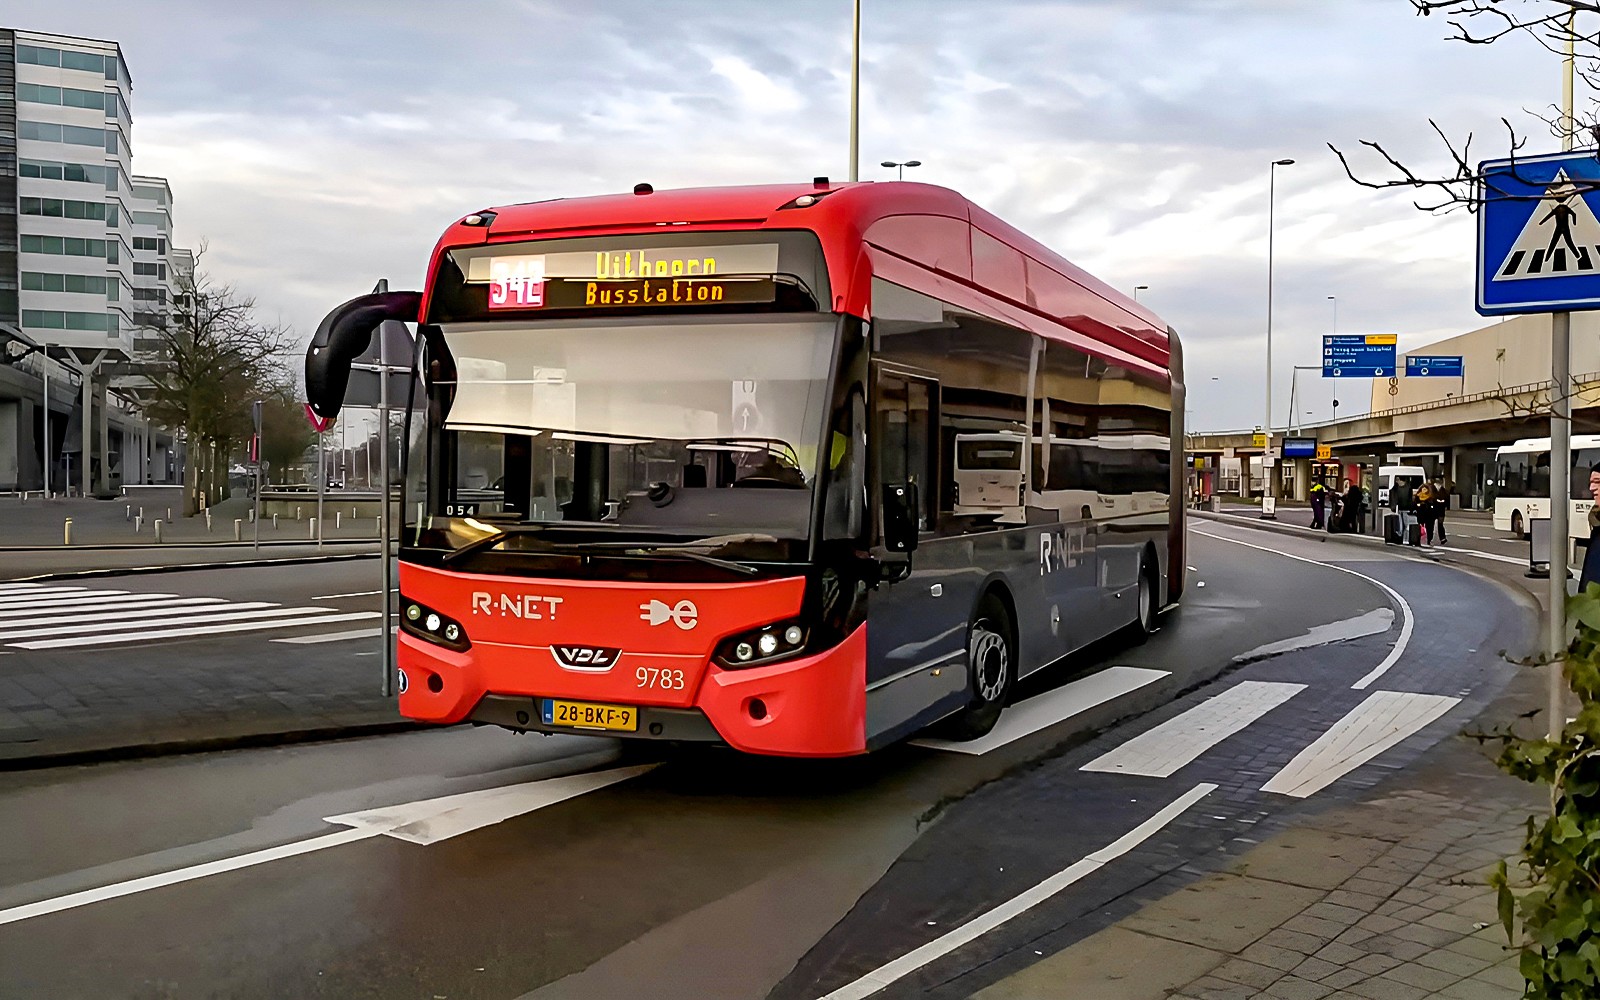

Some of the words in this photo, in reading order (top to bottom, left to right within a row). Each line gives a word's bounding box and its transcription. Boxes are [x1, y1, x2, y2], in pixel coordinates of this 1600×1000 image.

[596, 250, 716, 279] Uithoorn
[586, 280, 723, 305] Busstation
[446, 505, 474, 516] 054
[560, 647, 609, 664] VDL
[635, 666, 685, 690] 9783
[558, 704, 631, 726] 28-BKF-9
